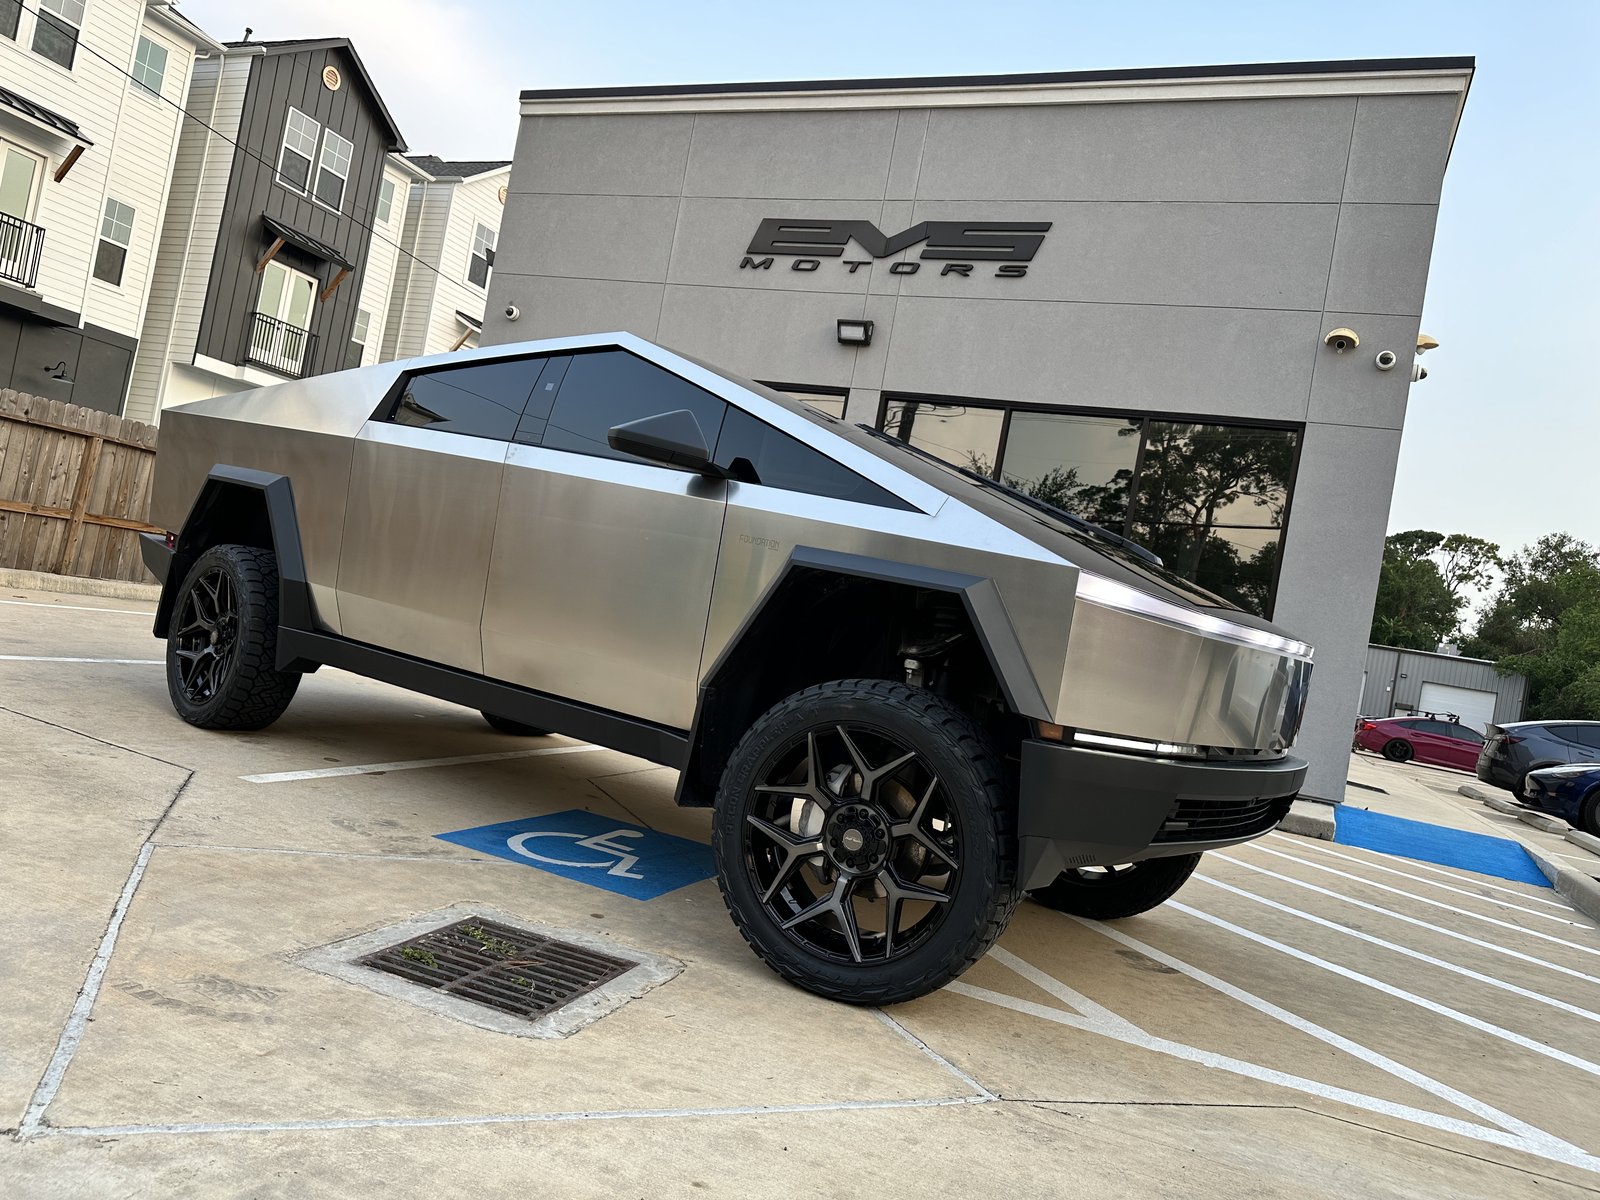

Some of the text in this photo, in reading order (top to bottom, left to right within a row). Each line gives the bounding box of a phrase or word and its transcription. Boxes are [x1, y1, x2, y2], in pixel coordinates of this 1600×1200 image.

[746, 217, 1053, 262] EVS
[739, 256, 1029, 278] MOTORS
[738, 534, 780, 549] FOUNDATION
